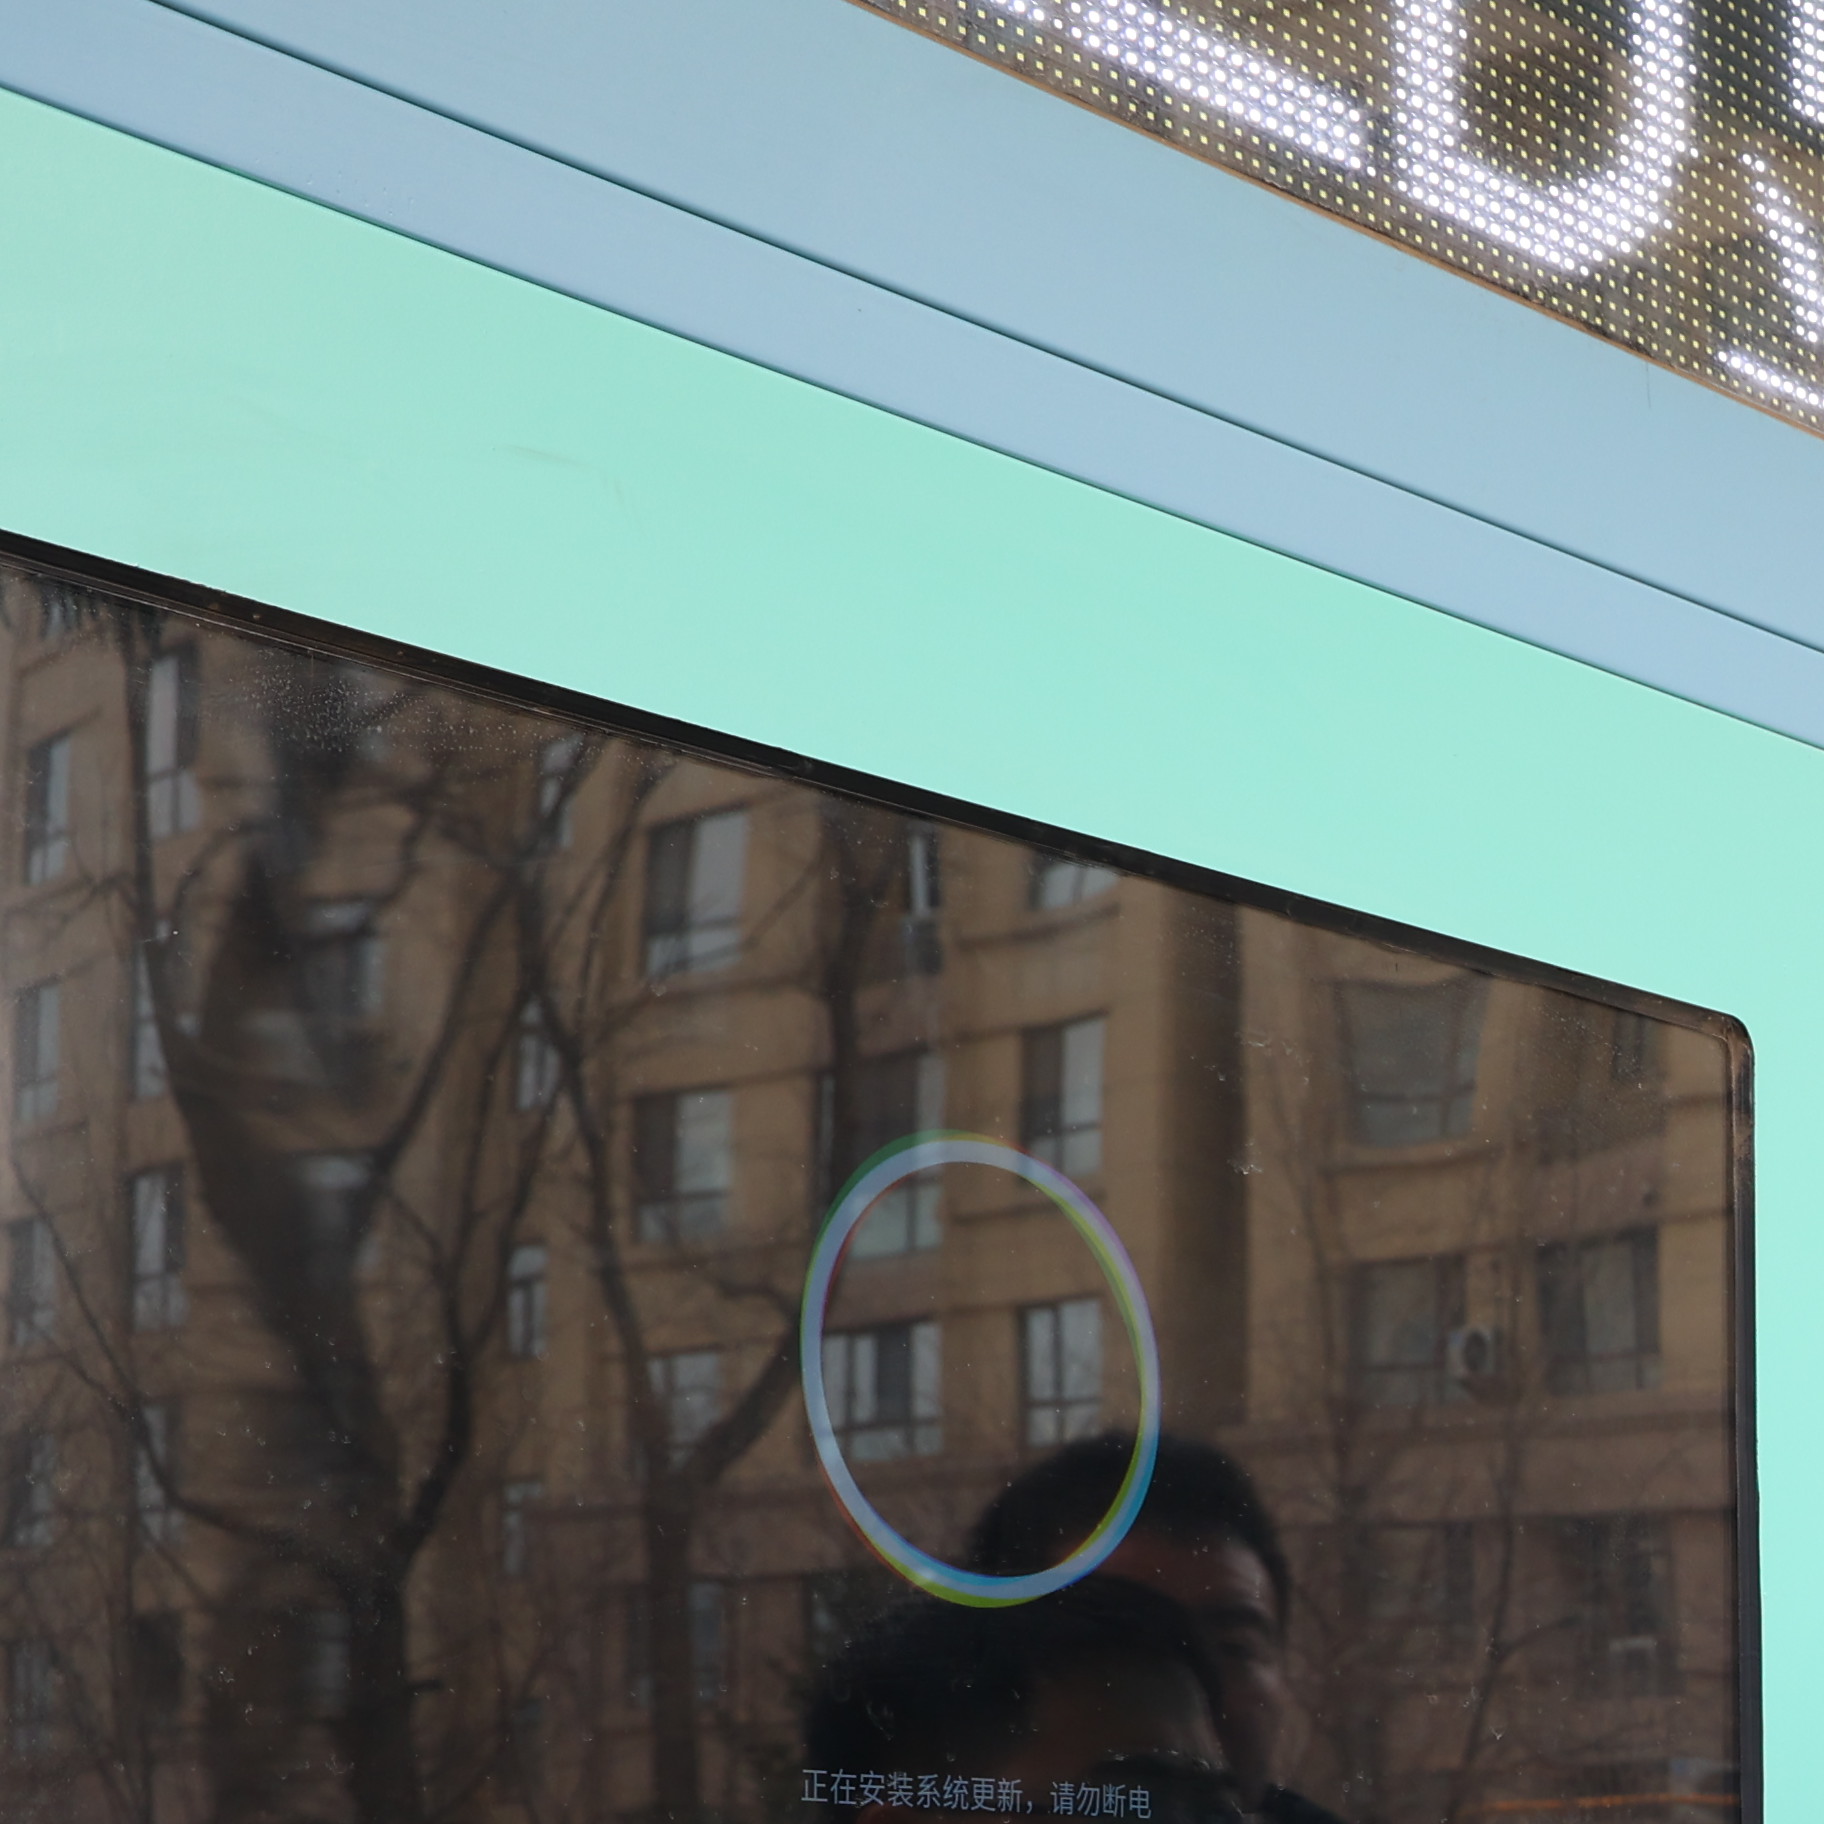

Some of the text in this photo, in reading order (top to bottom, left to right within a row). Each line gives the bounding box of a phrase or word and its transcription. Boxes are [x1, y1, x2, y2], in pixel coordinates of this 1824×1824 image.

[801, 1768, 1152, 1819] 正在安装系统更新，请勿断电
